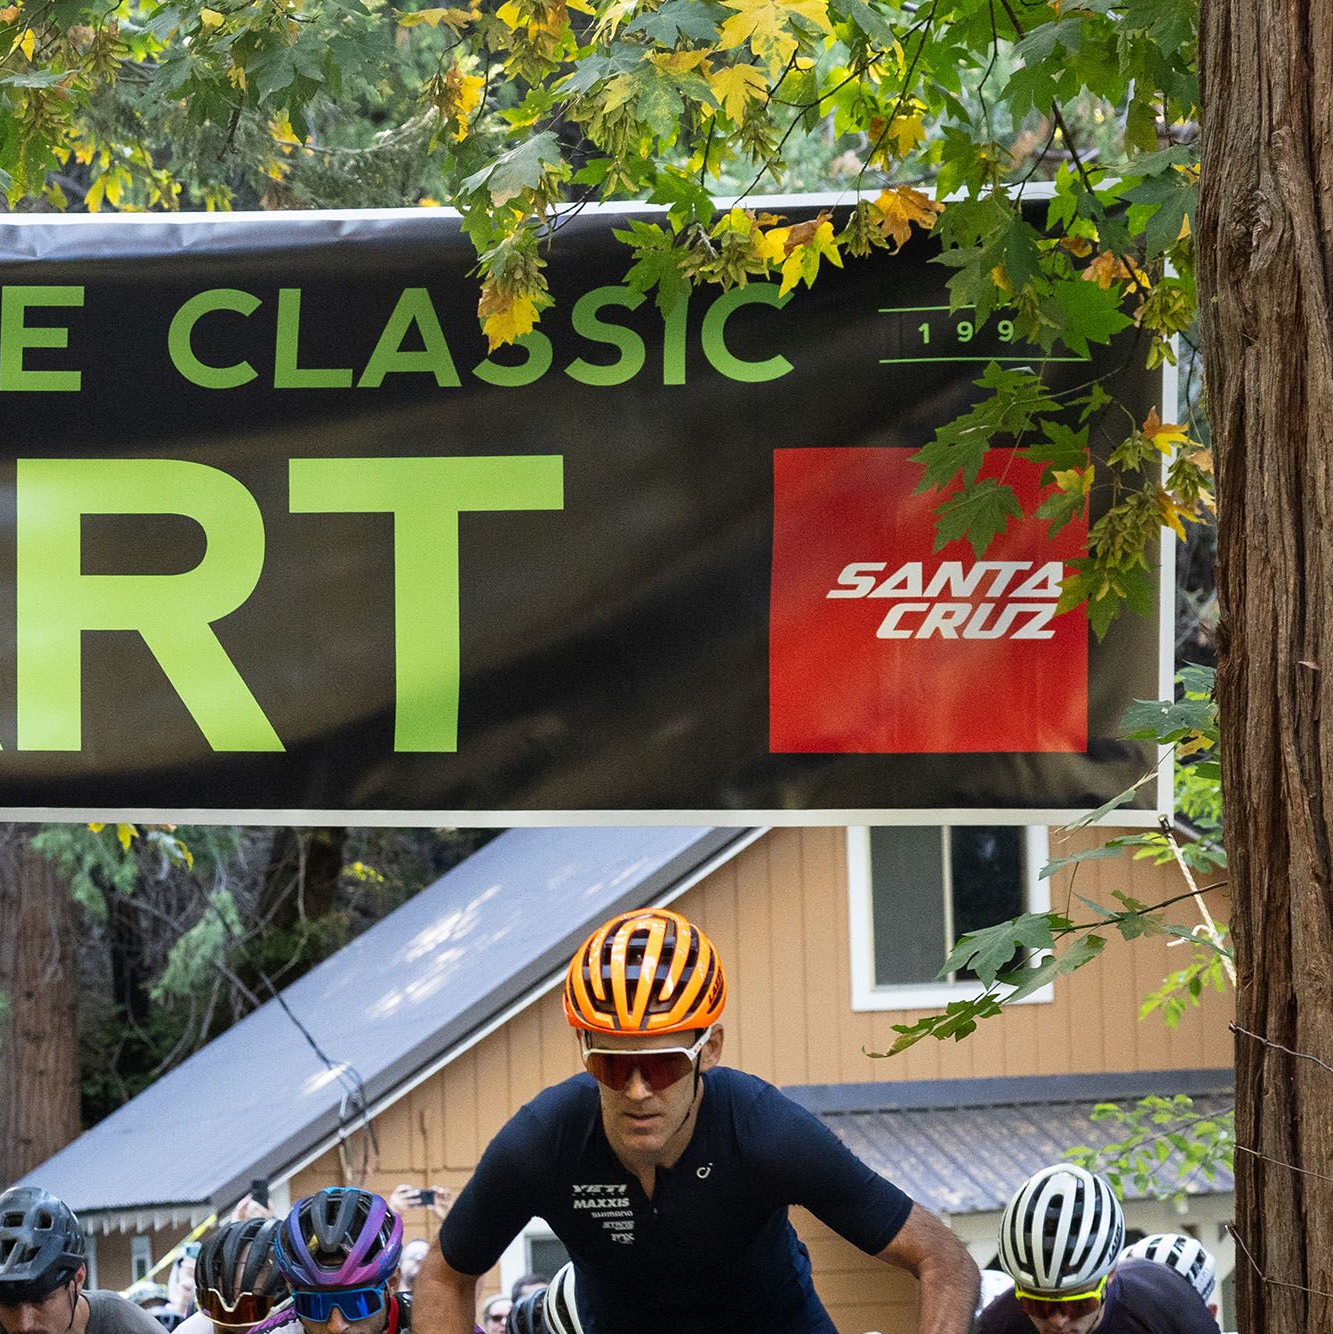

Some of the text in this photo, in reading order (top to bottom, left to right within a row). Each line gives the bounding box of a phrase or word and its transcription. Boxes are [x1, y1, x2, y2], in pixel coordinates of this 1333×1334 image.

[168, 282, 796, 391] CLASSIC
[917, 319, 1018, 345] 199
[826, 561, 1064, 599] SANTA
[875, 602, 1059, 640] CRUZ
[572, 1197, 630, 1210] MAXXIS
